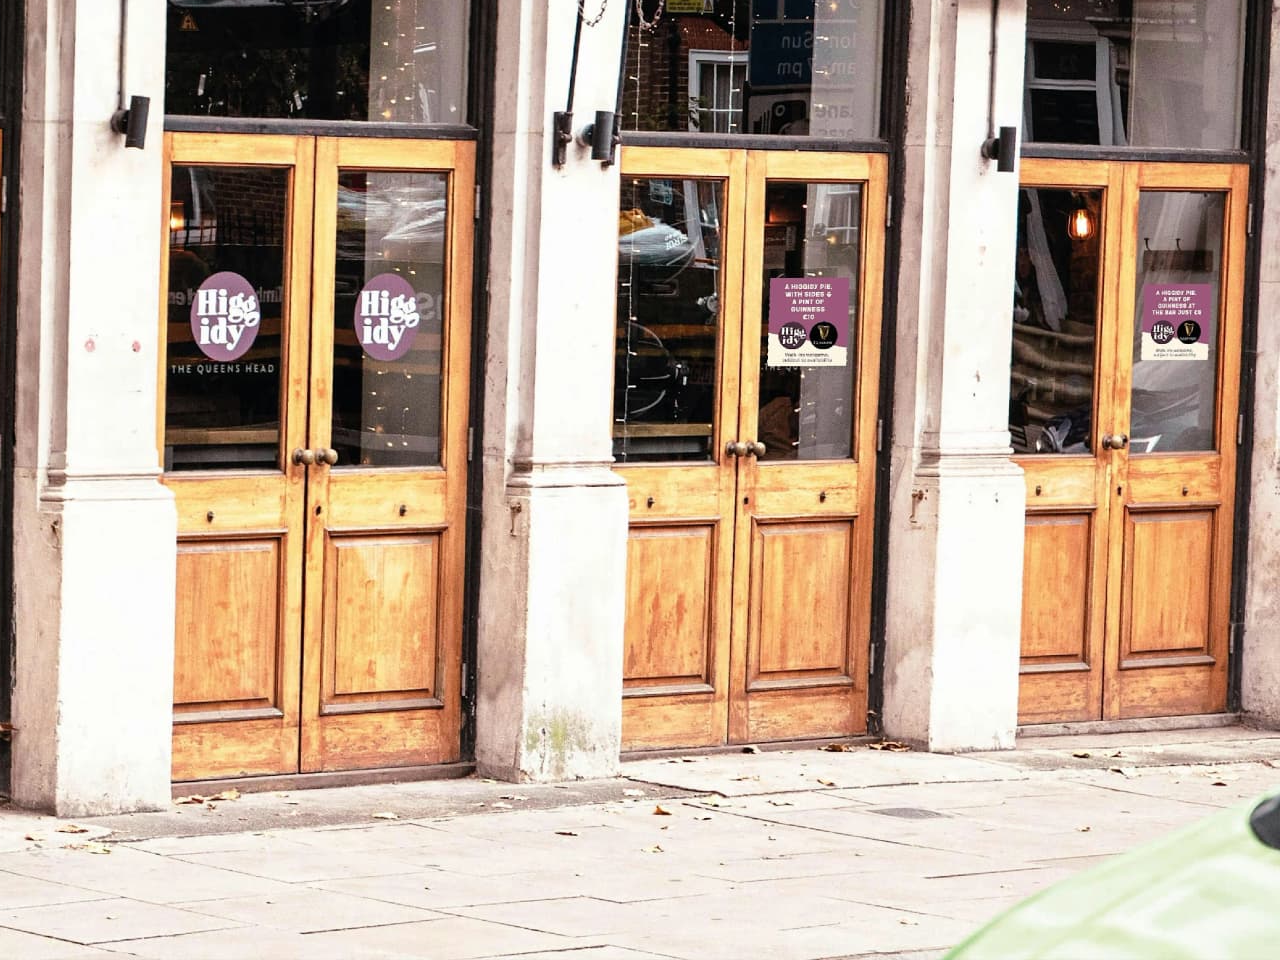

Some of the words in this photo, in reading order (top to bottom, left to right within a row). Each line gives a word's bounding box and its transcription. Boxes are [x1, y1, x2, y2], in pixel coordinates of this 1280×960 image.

[197, 289, 260, 327] Higg
[360, 290, 419, 327] Higg
[200, 317, 245, 350] idy
[363, 318, 405, 350] idy
[172, 365, 192, 373] THE
[197, 365, 240, 374] QUEENS
[245, 365, 274, 373] HEAD
